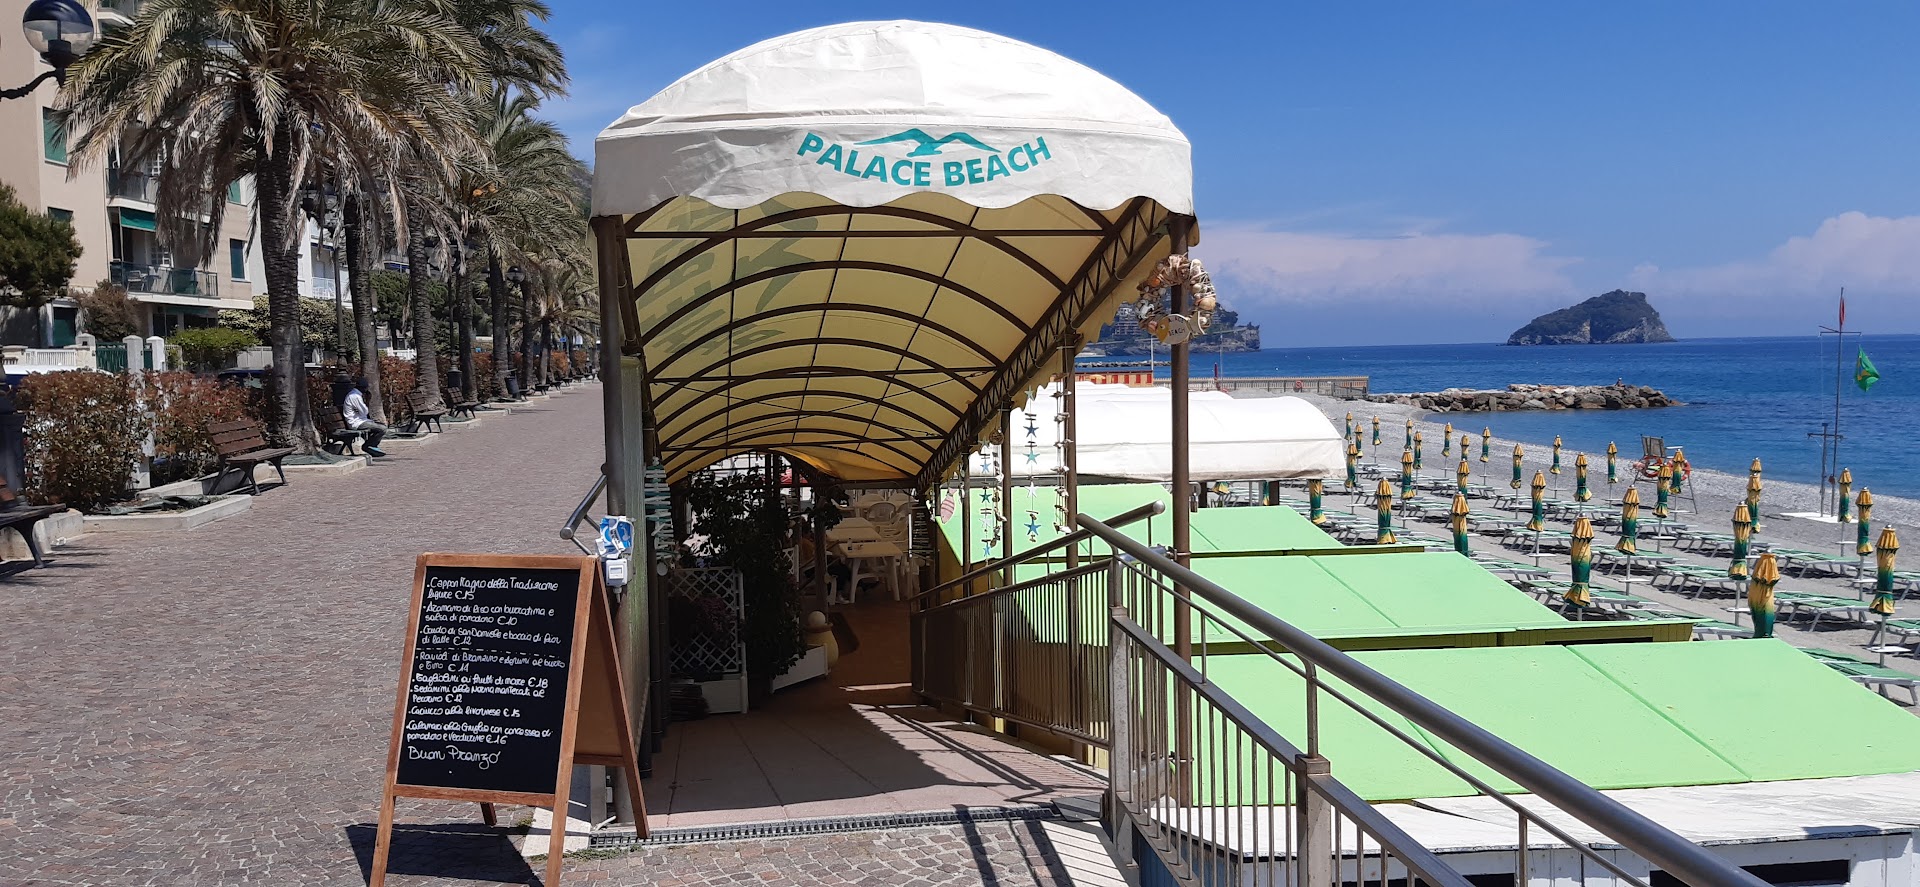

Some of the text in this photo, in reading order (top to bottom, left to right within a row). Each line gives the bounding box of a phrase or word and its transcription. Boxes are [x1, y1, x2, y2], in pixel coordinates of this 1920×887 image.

[797, 132, 1052, 187] PALACE BEACH
[487, 578, 508, 589] della
[510, 577, 558, 591] Tradizione
[462, 604, 472, 612] di
[424, 613, 448, 622] salsa
[449, 613, 458, 622] di
[458, 614, 494, 624] pomodoro
[422, 636, 430, 644] di
[432, 635, 450, 644] latte
[532, 634, 543, 642] di
[544, 633, 562, 644] fior
[452, 653, 461, 662] di
[532, 658, 543, 666] al
[472, 674, 494, 684] frutti
[494, 676, 504, 685] di
[504, 678, 525, 686] mare
[452, 684, 470, 693] alla
[532, 689, 545, 698] al
[445, 705, 463, 715] alla
[408, 720, 443, 730] Calamari
[443, 722, 460, 731] alla
[490, 726, 502, 734] con
[542, 729, 554, 738] di
[406, 732, 442, 742] pomodoro
[443, 733, 448, 741] e
[408, 746, 445, 760] Buon
